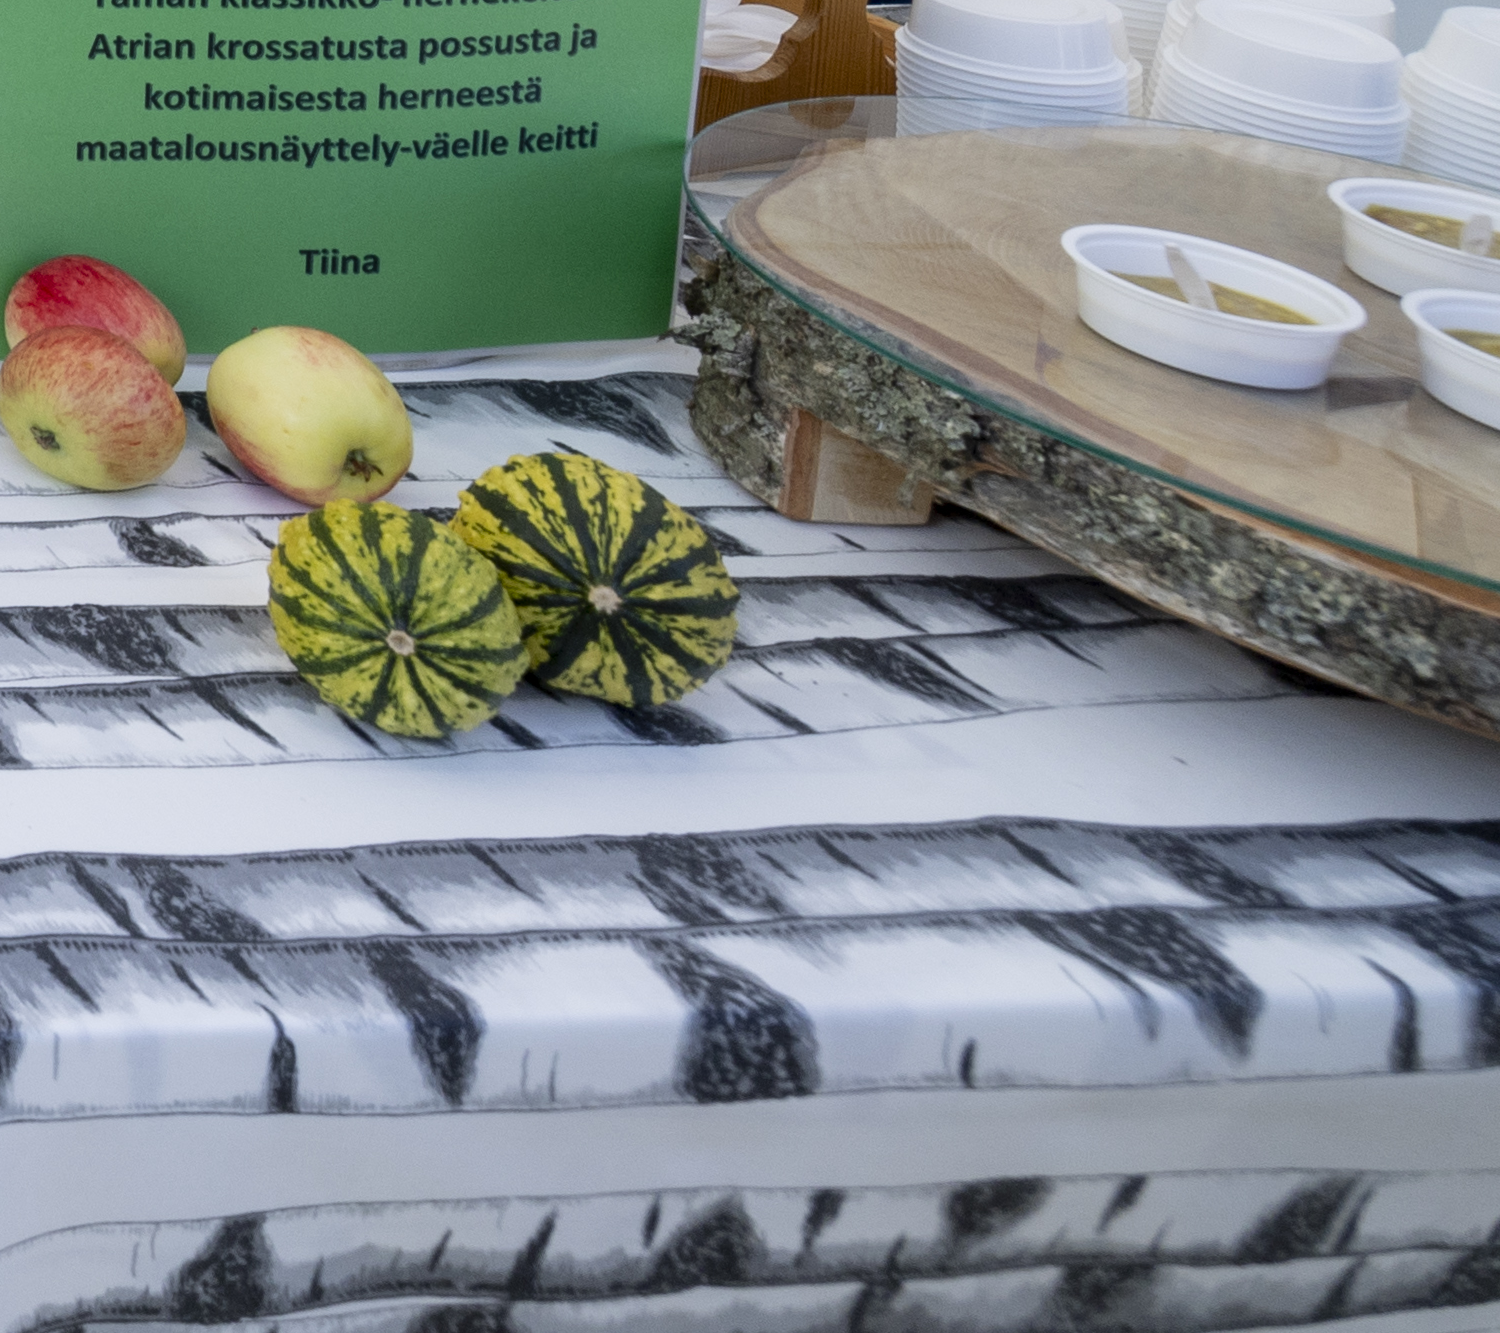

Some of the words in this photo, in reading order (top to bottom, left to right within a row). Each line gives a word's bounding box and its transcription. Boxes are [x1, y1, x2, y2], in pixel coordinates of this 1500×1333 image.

[87, 32, 196, 60] Atrian
[207, 31, 408, 61] krossatusta
[418, 28, 562, 66] possusta
[567, 22, 598, 57] ja
[144, 82, 367, 112] kotimaisesta
[378, 76, 542, 111] herneestä
[76, 128, 510, 169] maatalousnäyttely-väelle
[518, 121, 599, 155] keitti
[298, 248, 381, 276] Tiina
